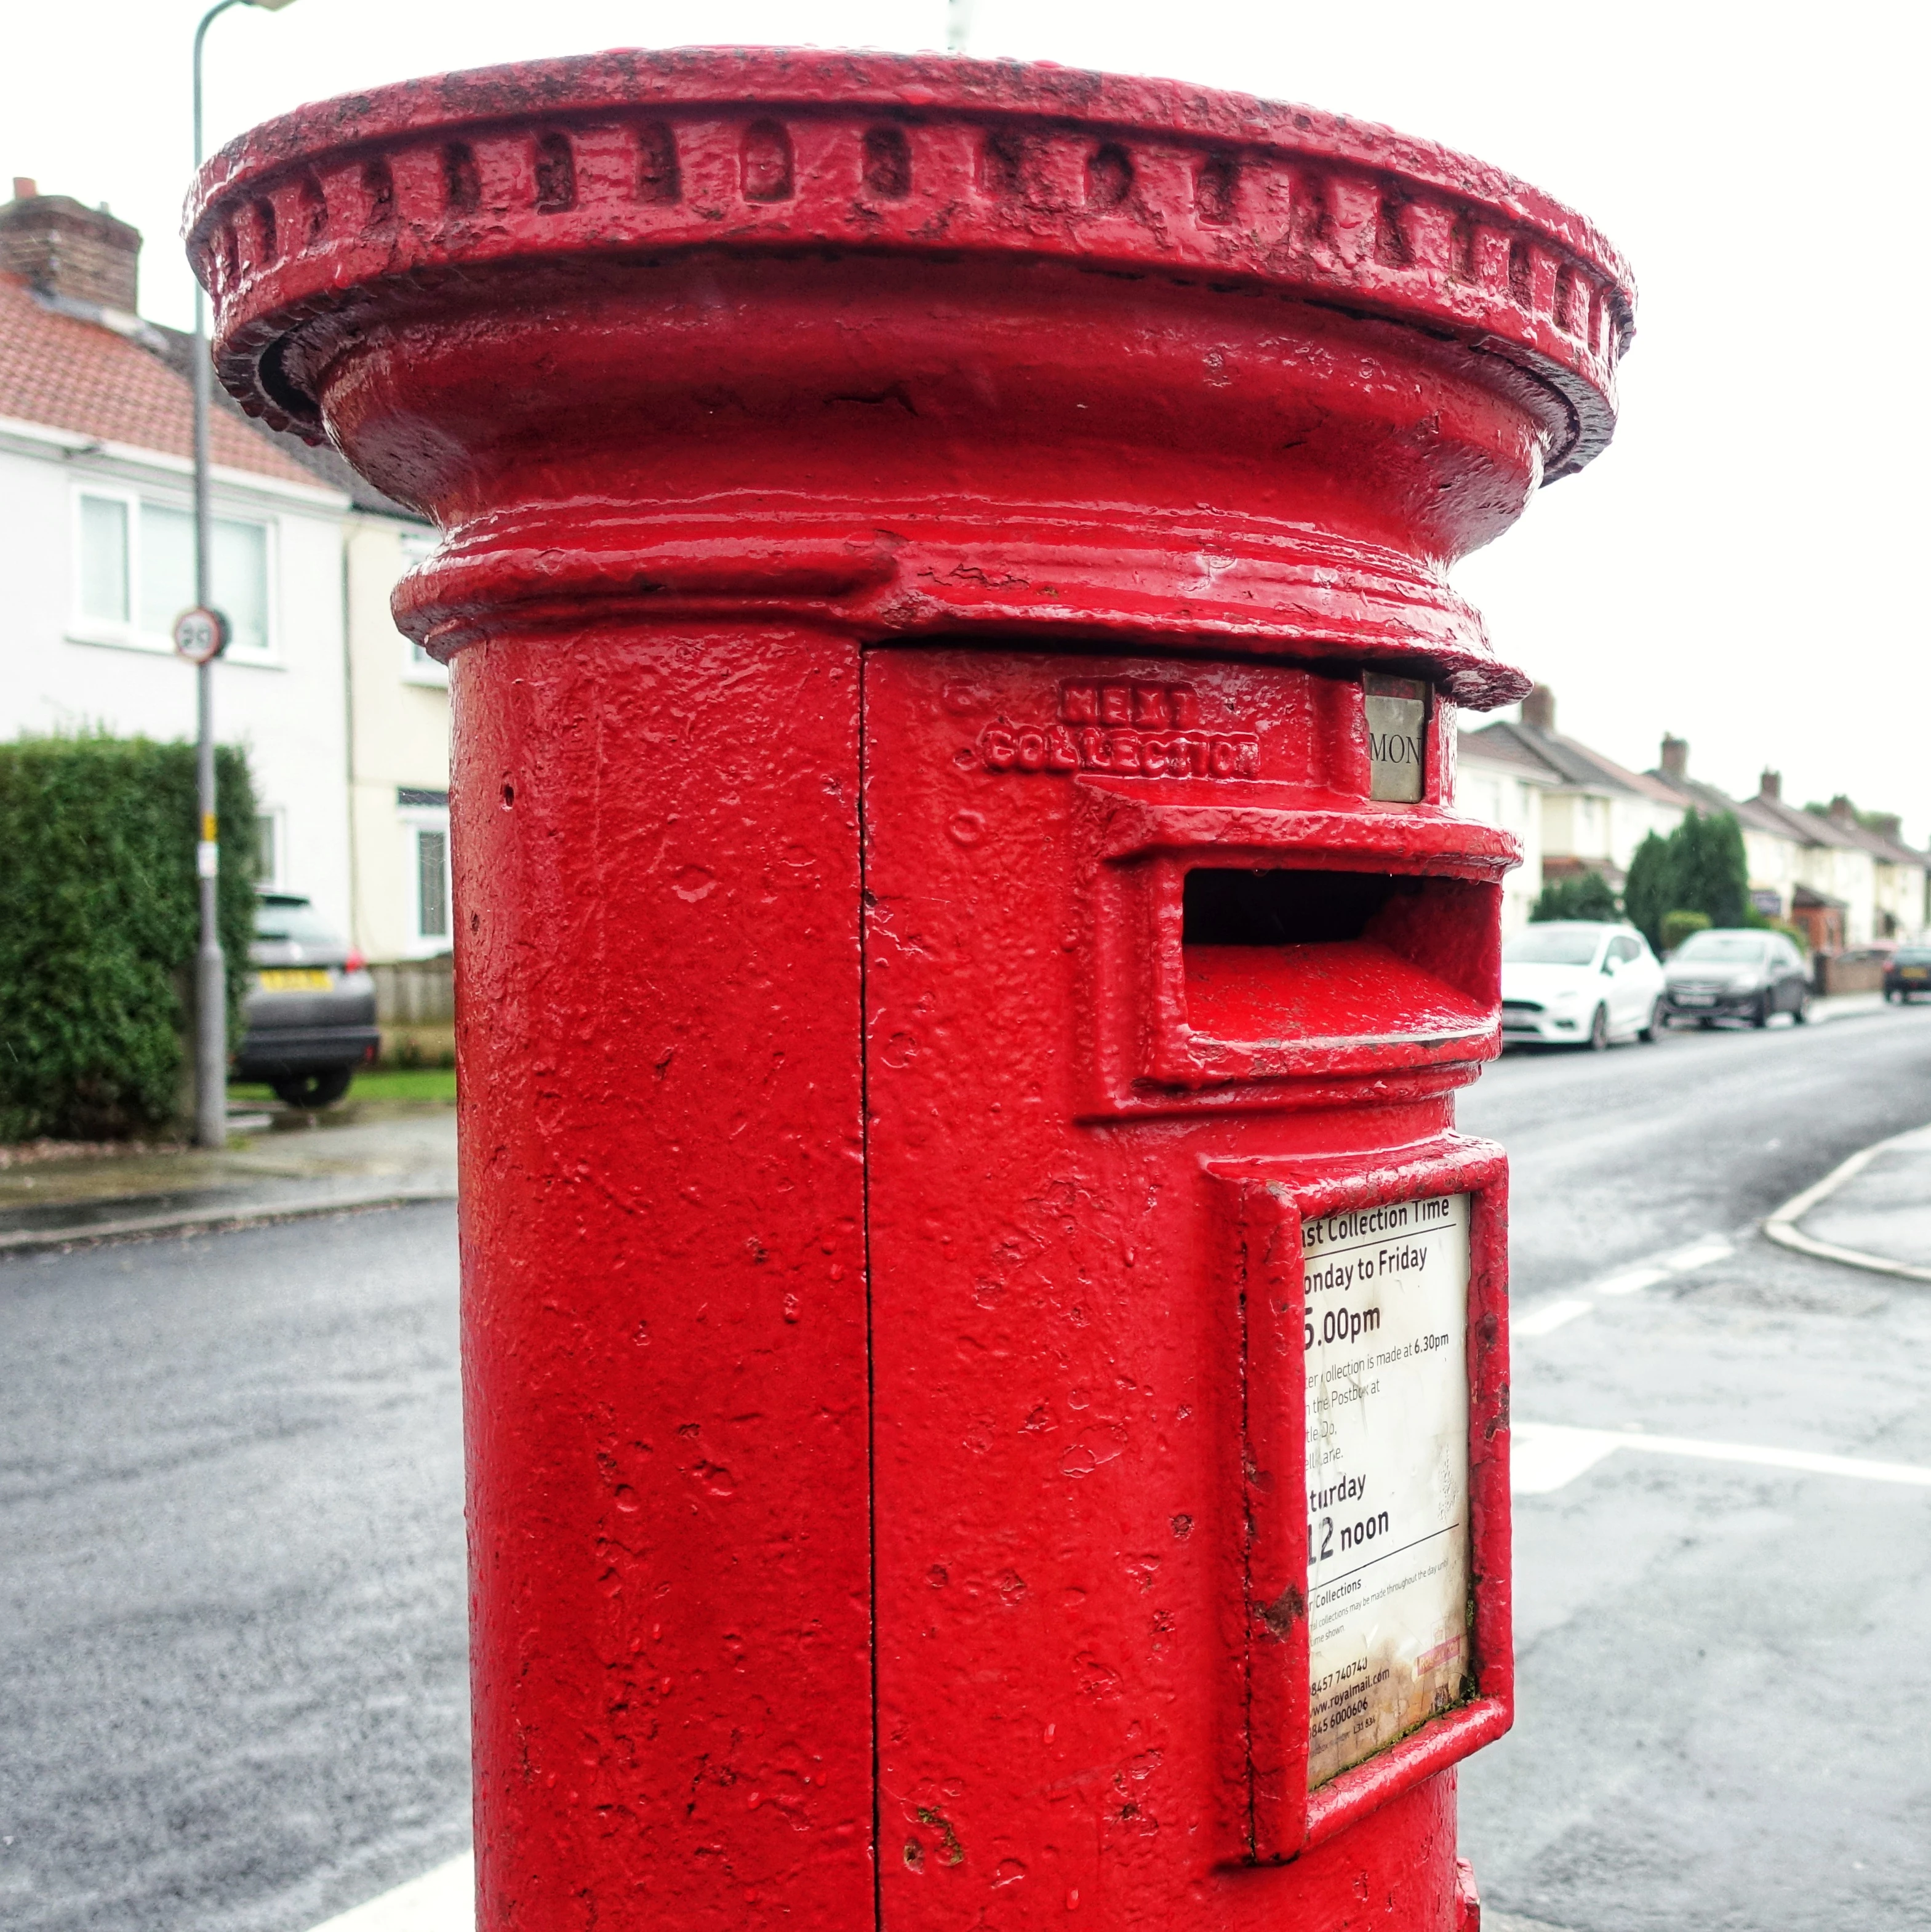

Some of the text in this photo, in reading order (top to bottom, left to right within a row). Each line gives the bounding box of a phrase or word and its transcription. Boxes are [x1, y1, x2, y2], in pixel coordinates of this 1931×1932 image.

[1060, 679, 1195, 725] NEXT
[1369, 732, 1421, 766] MON
[1328, 1204, 1407, 1241] Collection
[1415, 1199, 1449, 1222] Time
[1357, 1258, 1373, 1280] to
[1379, 1245, 1428, 1276] Friday
[1304, 1306, 1380, 1351] 5.00pm
[1367, 1353, 1374, 1369] is
[1377, 1345, 1402, 1367] made
[1404, 1342, 1412, 1358] at
[1414, 1333, 1449, 1354] 6.30pm
[1313, 1396, 1329, 1414] the
[1370, 1378, 1380, 1394] at
[1309, 1473, 1365, 1512] turday
[1308, 1511, 1389, 1566] 12 noon
[1316, 1578, 1361, 1608] Collections
[1319, 1606, 1349, 1627] collections
[1349, 1600, 1362, 1611] may
[1363, 1596, 1370, 1606] be
[1370, 1589, 1386, 1602] made
[1386, 1574, 1417, 1596] throughout
[1418, 1569, 1427, 1580] the
[1427, 1565, 1437, 1576] day
[1437, 1558, 1449, 1571] until
[1309, 1673, 1333, 1696] 8457
[1330, 1696, 1368, 1729] 6000606
